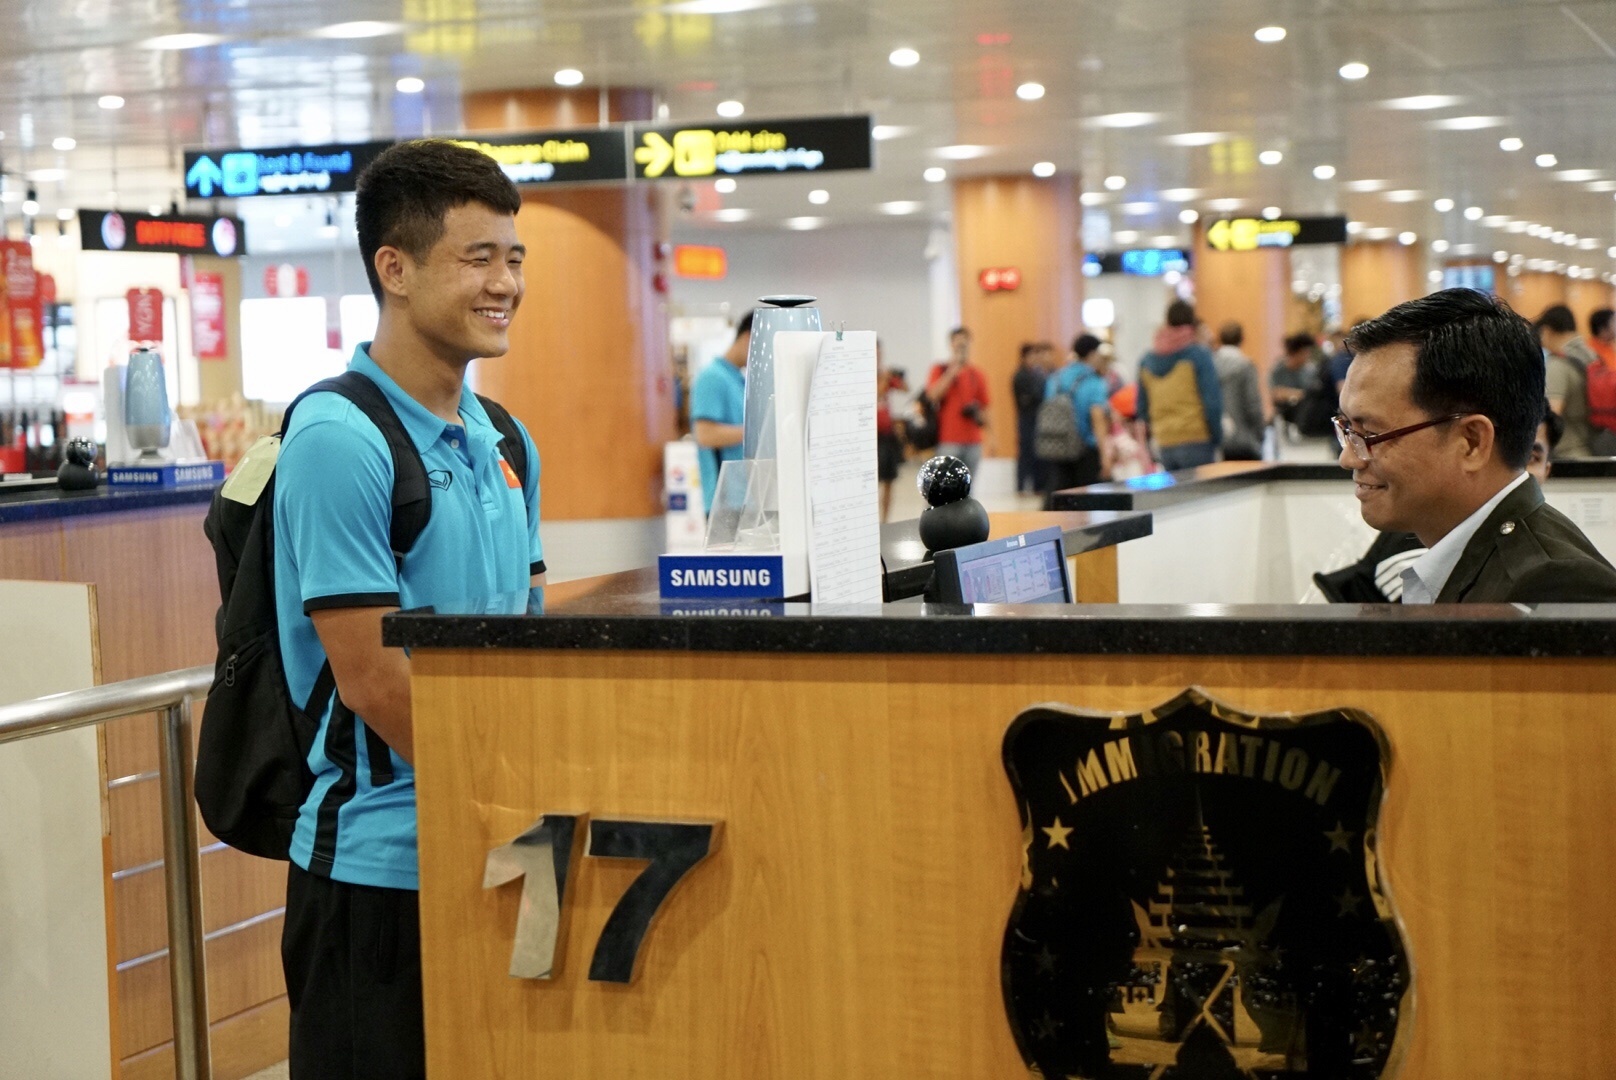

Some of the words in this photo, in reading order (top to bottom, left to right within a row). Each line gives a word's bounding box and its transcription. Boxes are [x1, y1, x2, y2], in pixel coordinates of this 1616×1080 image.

[543, 140, 589, 162] Claim
[304, 151, 351, 171] Found
[112, 471, 158, 483] SAMSUNG
[174, 465, 213, 482] SAMSUNG
[670, 569, 771, 587] SAMSUNG
[482, 812, 717, 984] 17
